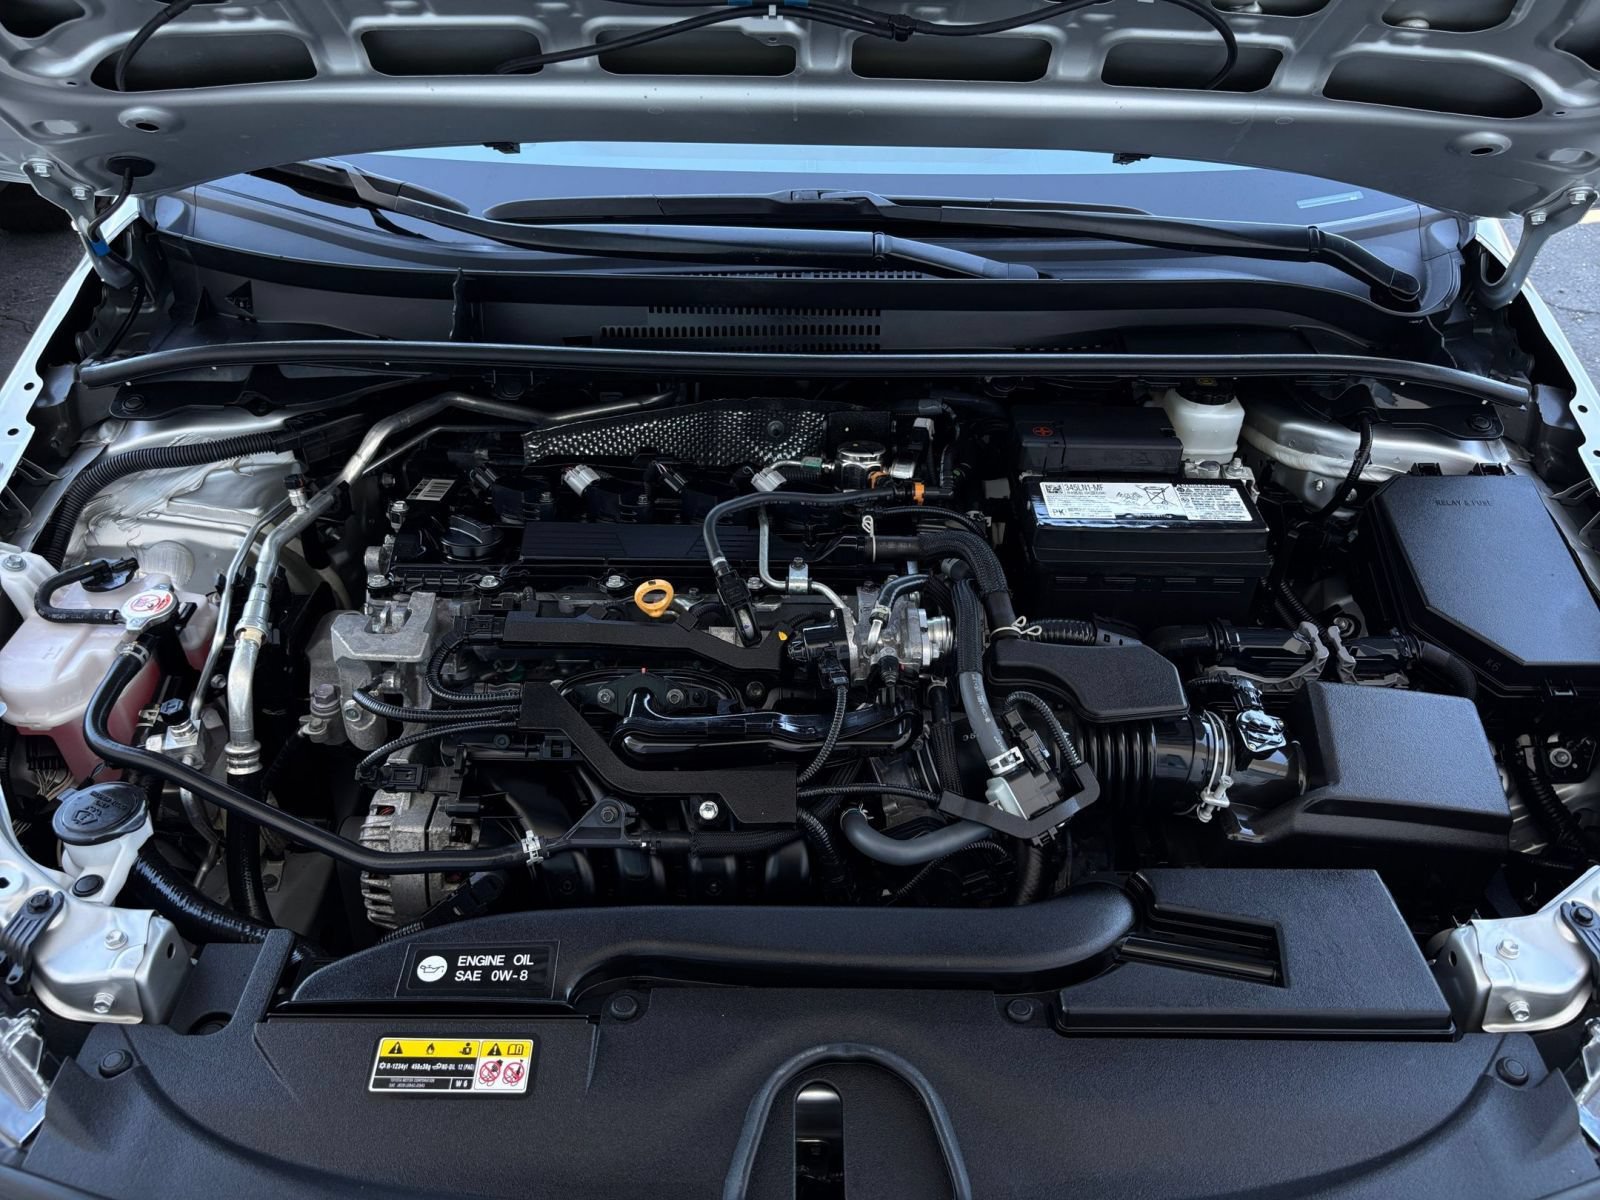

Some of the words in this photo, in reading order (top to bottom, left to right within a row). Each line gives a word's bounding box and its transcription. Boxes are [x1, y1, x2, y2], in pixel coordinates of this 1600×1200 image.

[457, 955, 505, 966] ENGINE
[513, 954, 534, 966] OIL
[454, 970, 482, 982] SAE
[491, 970, 528, 981] 0W-8
